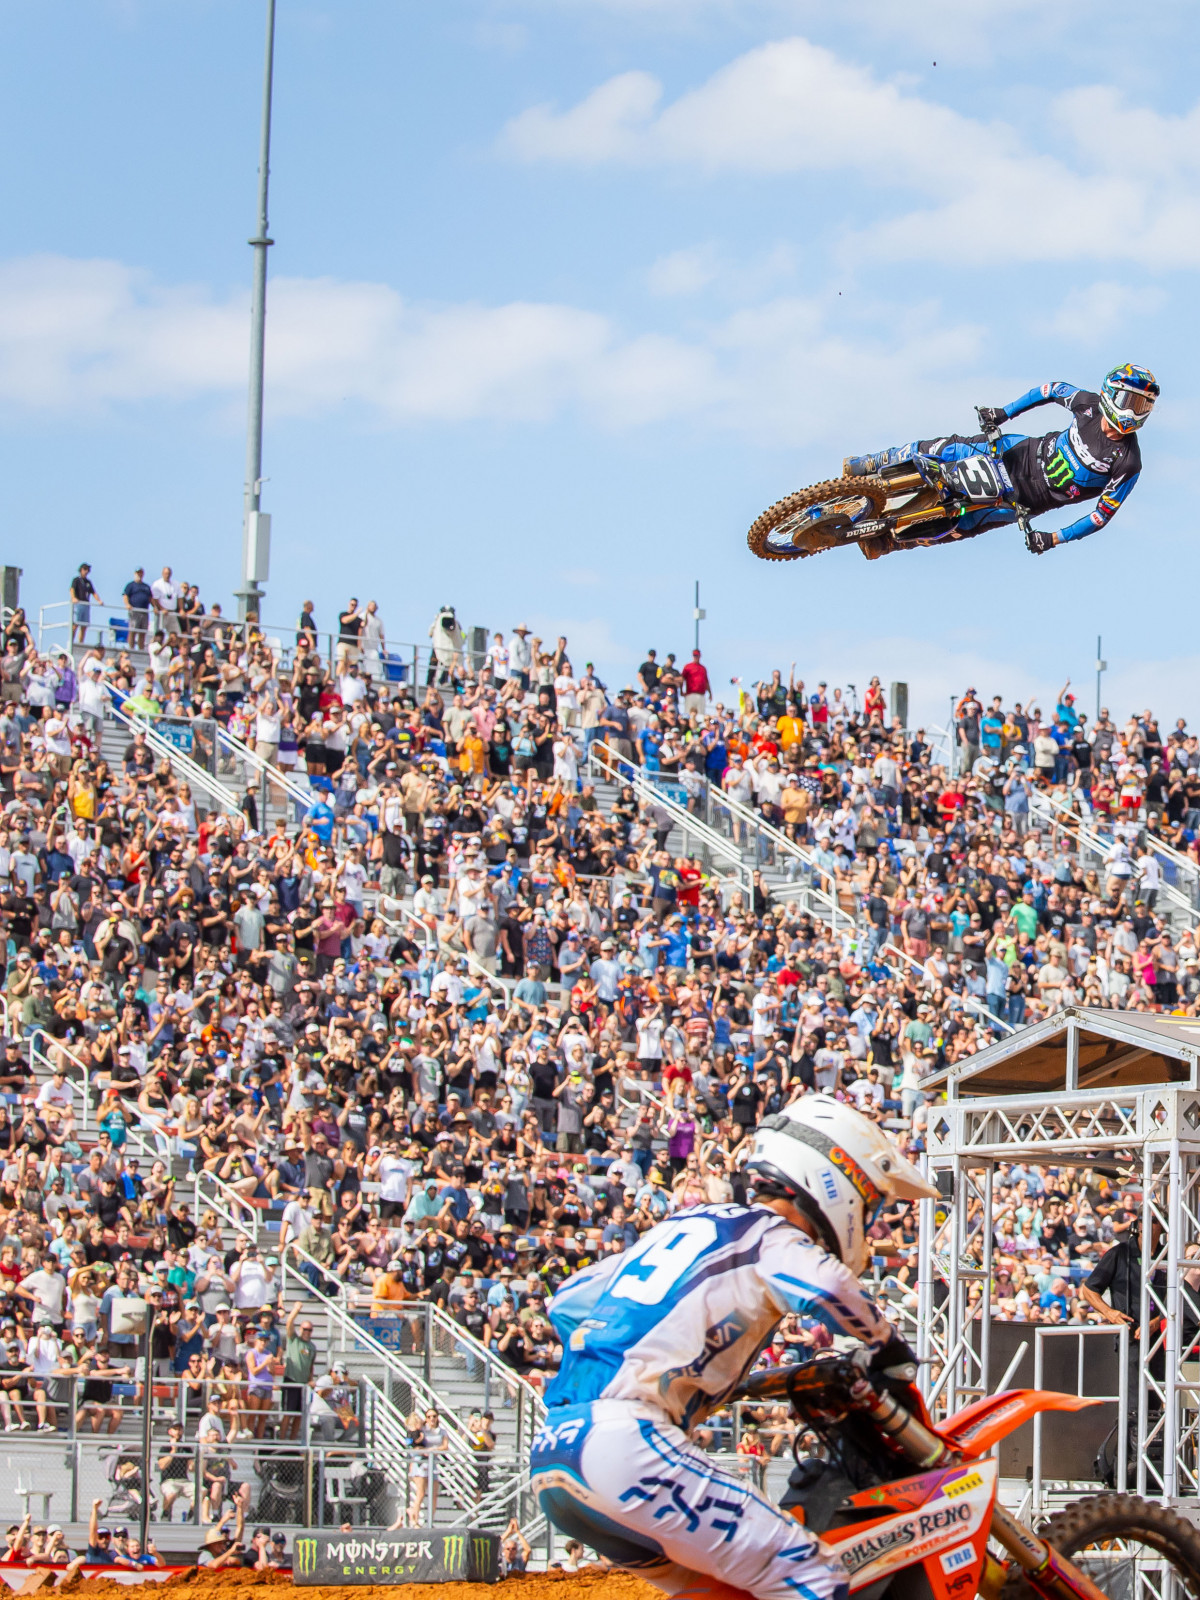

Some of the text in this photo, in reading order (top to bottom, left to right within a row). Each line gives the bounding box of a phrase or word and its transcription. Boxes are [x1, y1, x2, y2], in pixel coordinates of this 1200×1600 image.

[956, 458, 998, 498] 3
[845, 523, 886, 538] DUNLOP
[821, 1170, 838, 1200] TRB
[829, 1146, 879, 1203] OAKLEY
[918, 1503, 972, 1537] RENO
[326, 1537, 434, 1564] MONSTER
[944, 1547, 973, 1568] TRB
[342, 1566, 417, 1576] ENERGY
